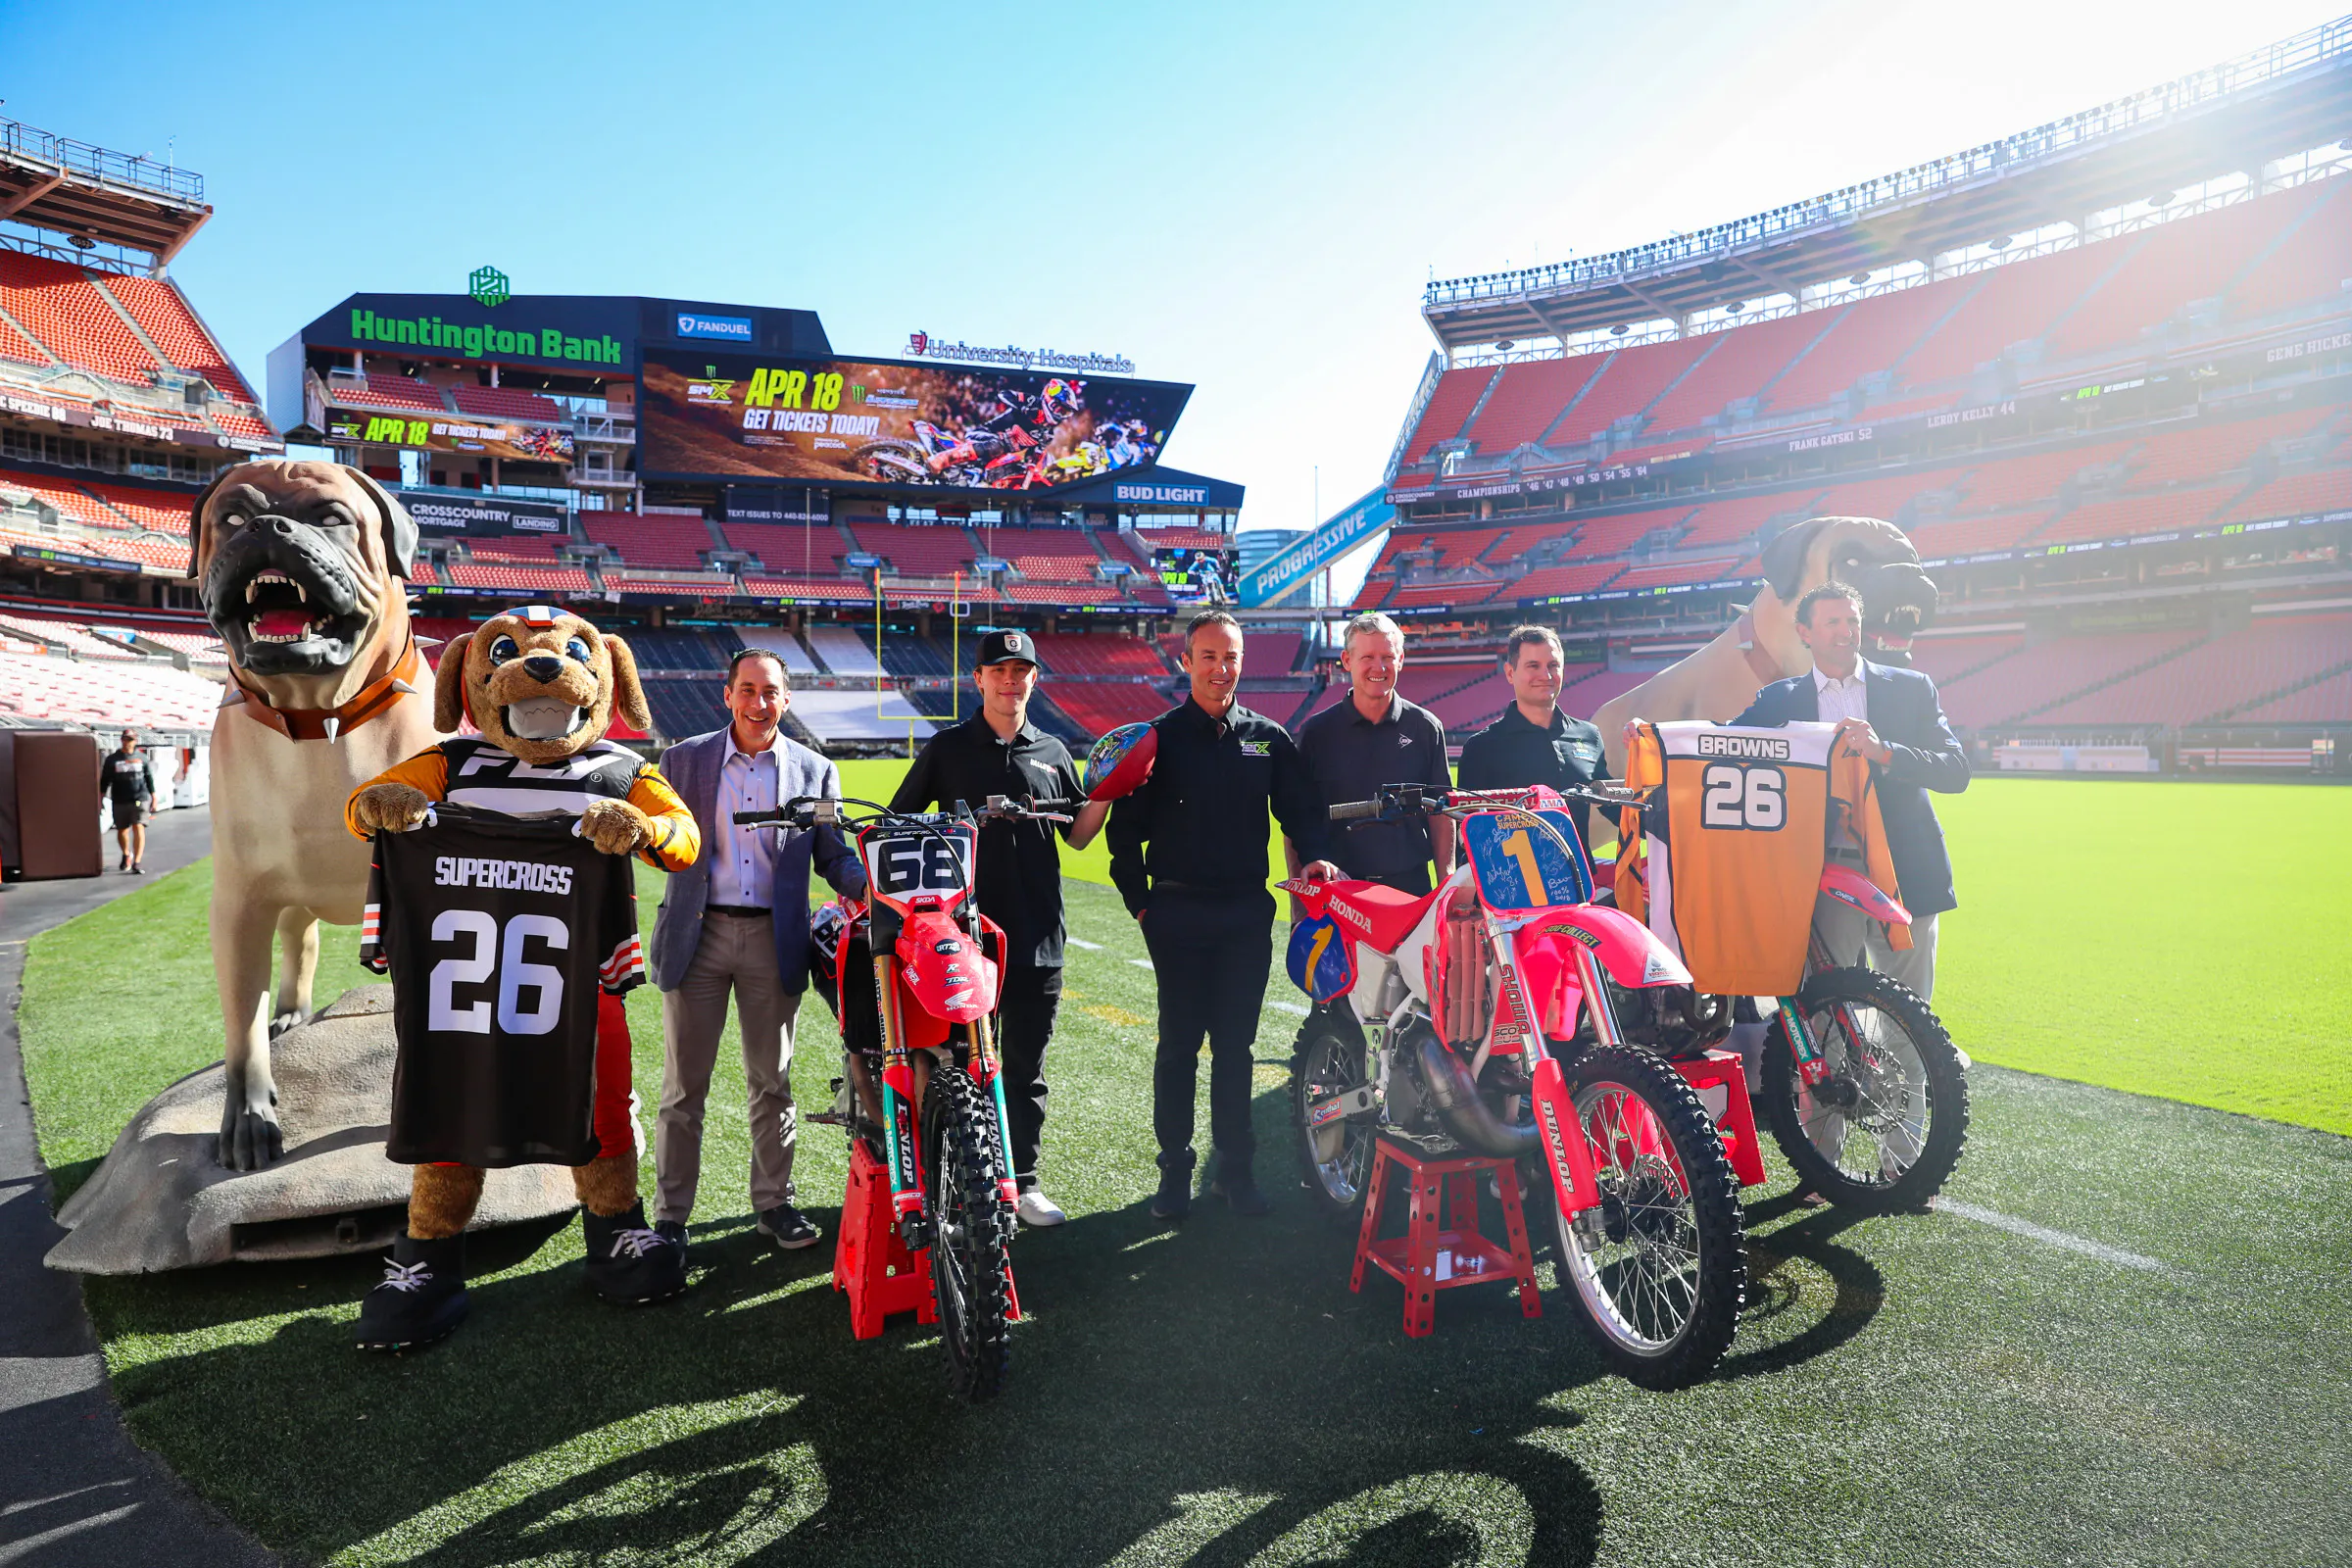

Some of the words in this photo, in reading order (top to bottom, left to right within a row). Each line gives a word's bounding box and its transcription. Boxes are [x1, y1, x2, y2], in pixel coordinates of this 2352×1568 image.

[352, 310, 536, 359] Huntington
[542, 329, 621, 364] Bank
[697, 321, 751, 335] FANDUEL
[929, 339, 1034, 370] University
[1040, 349, 1132, 375] Hospitals
[2267, 344, 2303, 363] GENE
[687, 382, 732, 401] SMX
[744, 368, 808, 410] APR
[810, 371, 844, 412] 18
[8, 398, 50, 417] SPEEDIE
[1928, 412, 1959, 428] LEROY
[1961, 406, 1995, 422] KELLY
[2000, 401, 2016, 415] 44
[91, 416, 113, 429] JOE
[114, 419, 158, 439] THOMAS
[159, 426, 173, 441] 73
[364, 416, 403, 445] APR
[408, 420, 429, 446] 18
[743, 409, 771, 430] GET
[772, 411, 827, 434] TICKETS
[829, 413, 880, 436] TODAY!
[814, 441, 848, 450] peacock
[1788, 437, 1819, 452] FRANK
[1820, 431, 1854, 447] GATSKI
[1858, 428, 1873, 441] 52
[1117, 486, 1156, 501] BUD
[1156, 488, 1205, 503] LIGHT
[1457, 484, 1521, 499] CHAMPIONSHIPS
[411, 503, 511, 523] CROSSCOUNTRY
[413, 514, 466, 528] MORTGAGE
[515, 517, 558, 530] LANDING
[727, 509, 746, 517] TEXT
[747, 511, 770, 519] ISSUES
[1256, 508, 1367, 596] PROGRESSIVE
[1699, 736, 1789, 760] BROWNS
[1540, 799, 1564, 808] AMA
[1703, 763, 1785, 830] 26
[435, 856, 574, 896] SUPERCROSS
[878, 838, 965, 895] 68
[1501, 830, 1548, 906] 1
[1329, 894, 1372, 935] HONDA
[1305, 924, 1334, 993] 1
[428, 909, 569, 1036] 26
[1499, 963, 1531, 1035] SHOWA
[1787, 1016, 1809, 1058] MOTOREX
[885, 1130, 898, 1187] MOTOREX
[1540, 1099, 1576, 1194] DUNLOP
